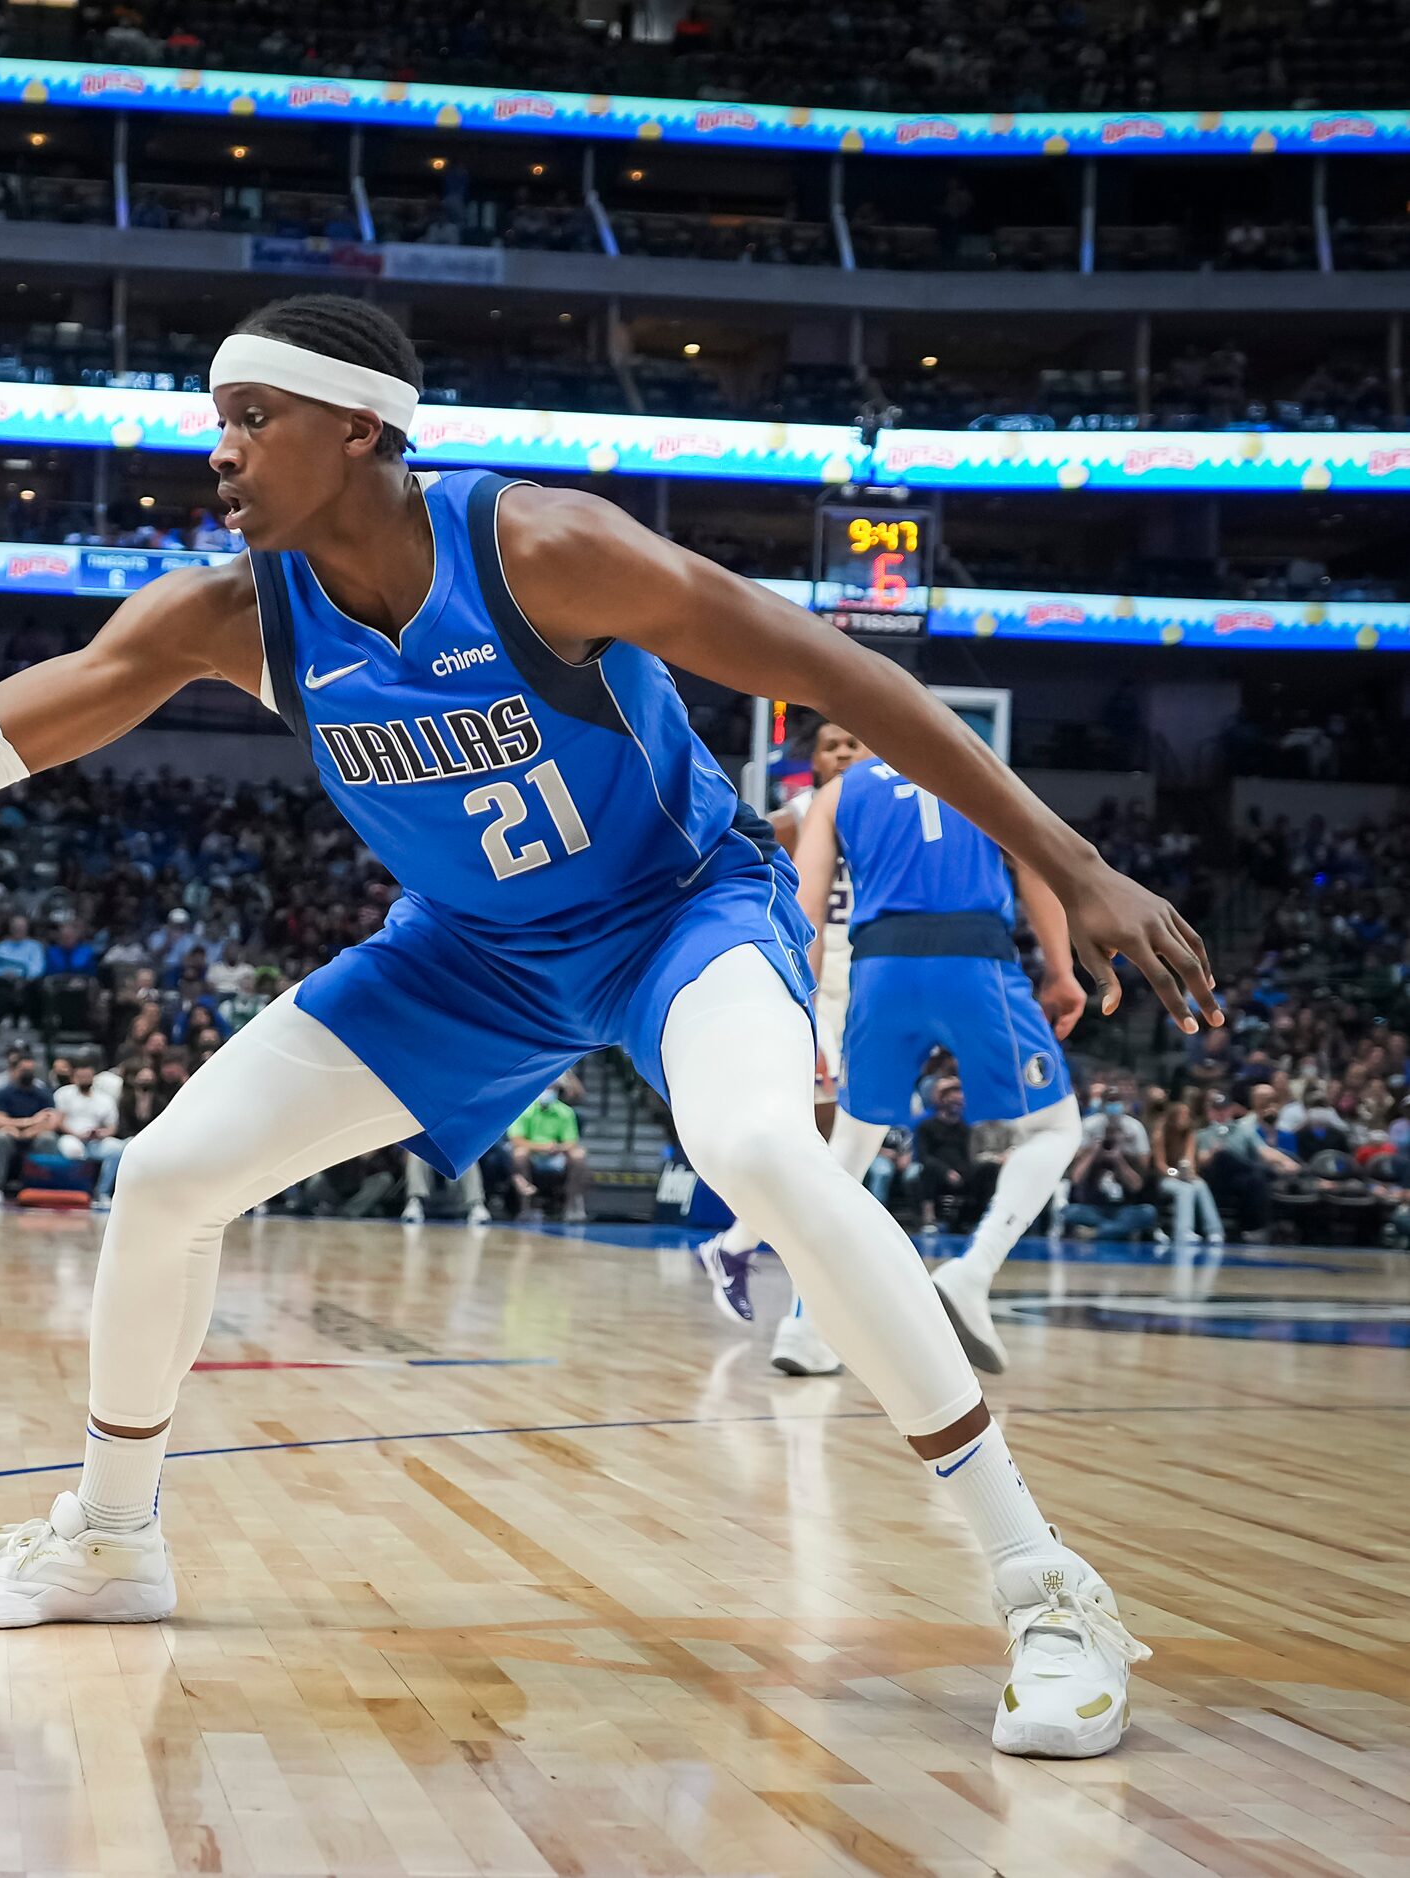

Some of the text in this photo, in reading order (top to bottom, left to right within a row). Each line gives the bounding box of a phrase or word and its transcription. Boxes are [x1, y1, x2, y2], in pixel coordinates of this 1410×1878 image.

[850, 518, 918, 552] 9:47
[873, 553, 907, 607] 6
[850, 613, 924, 632] TISSOT
[431, 643, 498, 677] chime
[315, 693, 543, 785] DALLAS
[462, 758, 592, 882] 21
